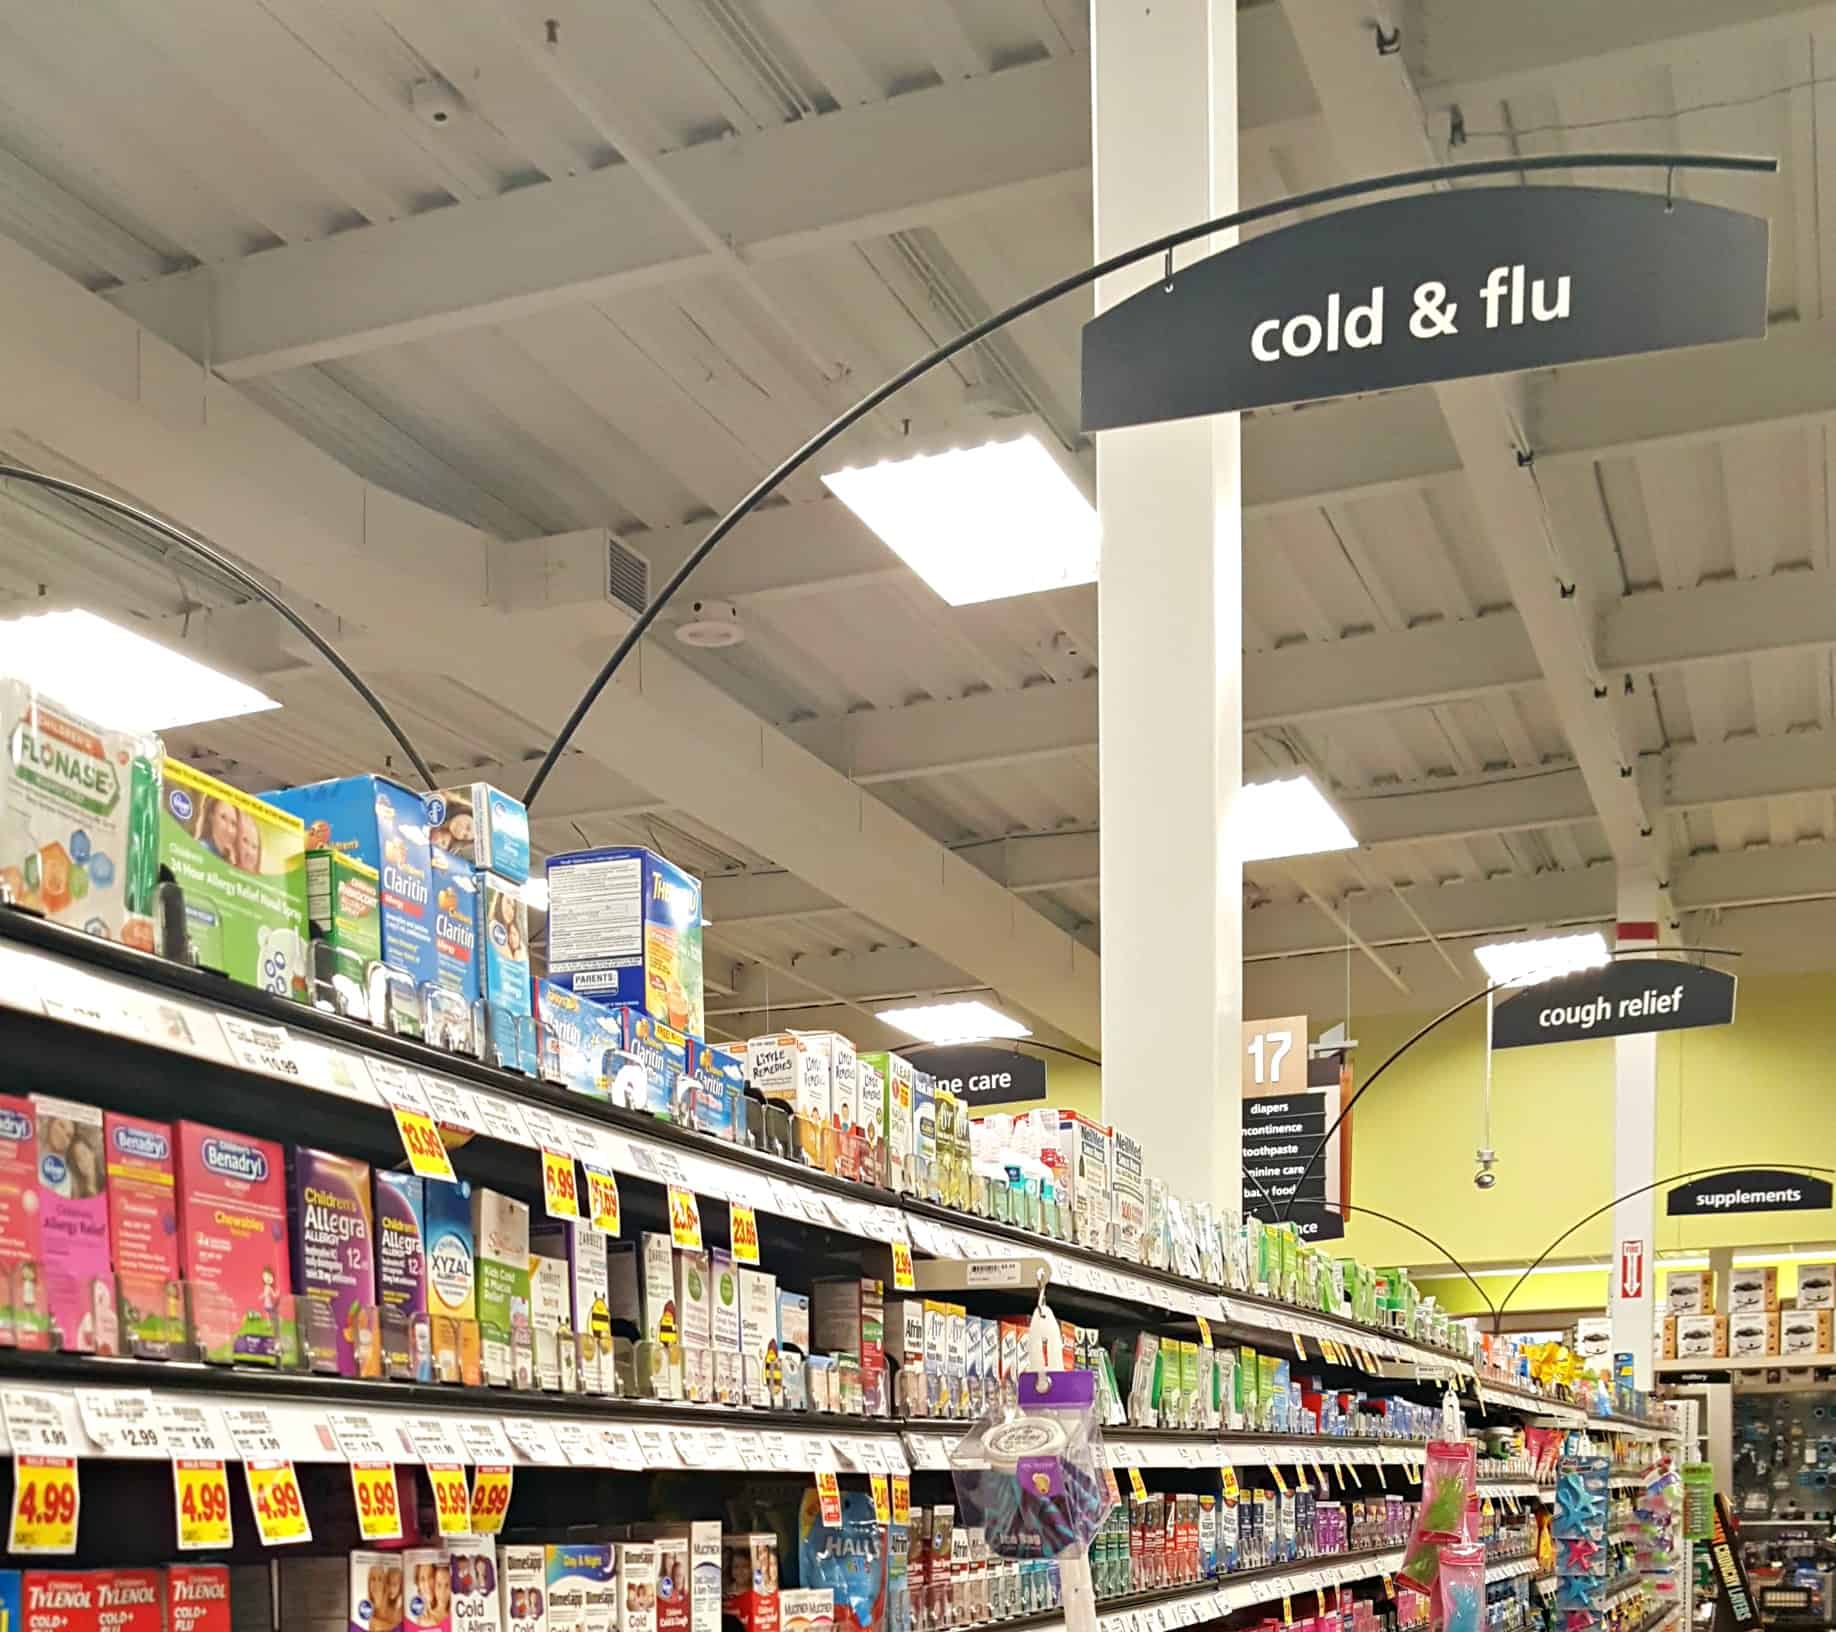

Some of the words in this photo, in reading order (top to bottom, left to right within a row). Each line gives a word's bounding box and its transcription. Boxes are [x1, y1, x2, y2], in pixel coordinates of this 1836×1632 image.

[1250, 286, 1384, 362] cold
[1408, 280, 1459, 338] &
[1480, 264, 1573, 328] flu
[21, 733, 109, 794] FLONASE
[383, 866, 428, 904] Claritin
[435, 914, 475, 949] Claritin
[1538, 995, 1611, 1030] cough
[1617, 984, 1684, 1019] relief
[630, 1038, 665, 1073] Claritin
[1247, 1031, 1292, 1084] 17
[969, 1072, 1012, 1091] care
[1250, 1103, 1289, 1116] diapers
[1241, 1122, 1304, 1137] ncontinence
[117, 1131, 165, 1158] Benadryl
[1242, 1143, 1299, 1158] toothpaste
[206, 1148, 263, 1178] Benadryl
[1282, 1166, 1305, 1176] care
[545, 1165, 576, 1200] 6.99
[1271, 1184, 1297, 1196] food
[303, 1187, 357, 1213] Children's
[1695, 1188, 1802, 1209] supplements
[303, 1204, 366, 1239] Allegra
[381, 1229, 423, 1254] Allegra
[346, 1248, 362, 1269] 12
[407, 1259, 419, 1276] 12
[431, 1253, 472, 1276] XYZAL
[904, 1319, 923, 1339] Afrin
[19, 1482, 76, 1524] 4.99
[180, 1482, 228, 1523] 4.99
[256, 1482, 301, 1520] 4.99
[358, 1481, 396, 1518] 9.99
[435, 1480, 470, 1516] 9.99
[471, 1483, 510, 1517] 9.99
[29, 1586, 92, 1610] TYLENOL
[97, 1583, 157, 1608] TYLENOL
[173, 1580, 227, 1602] TYLENOL
[29, 1612, 69, 1629] COLD+
[99, 1610, 135, 1626] COLD+
[174, 1606, 208, 1619] COLD+
[455, 1600, 485, 1619] Cold
[174, 1618, 195, 1632] FLU
